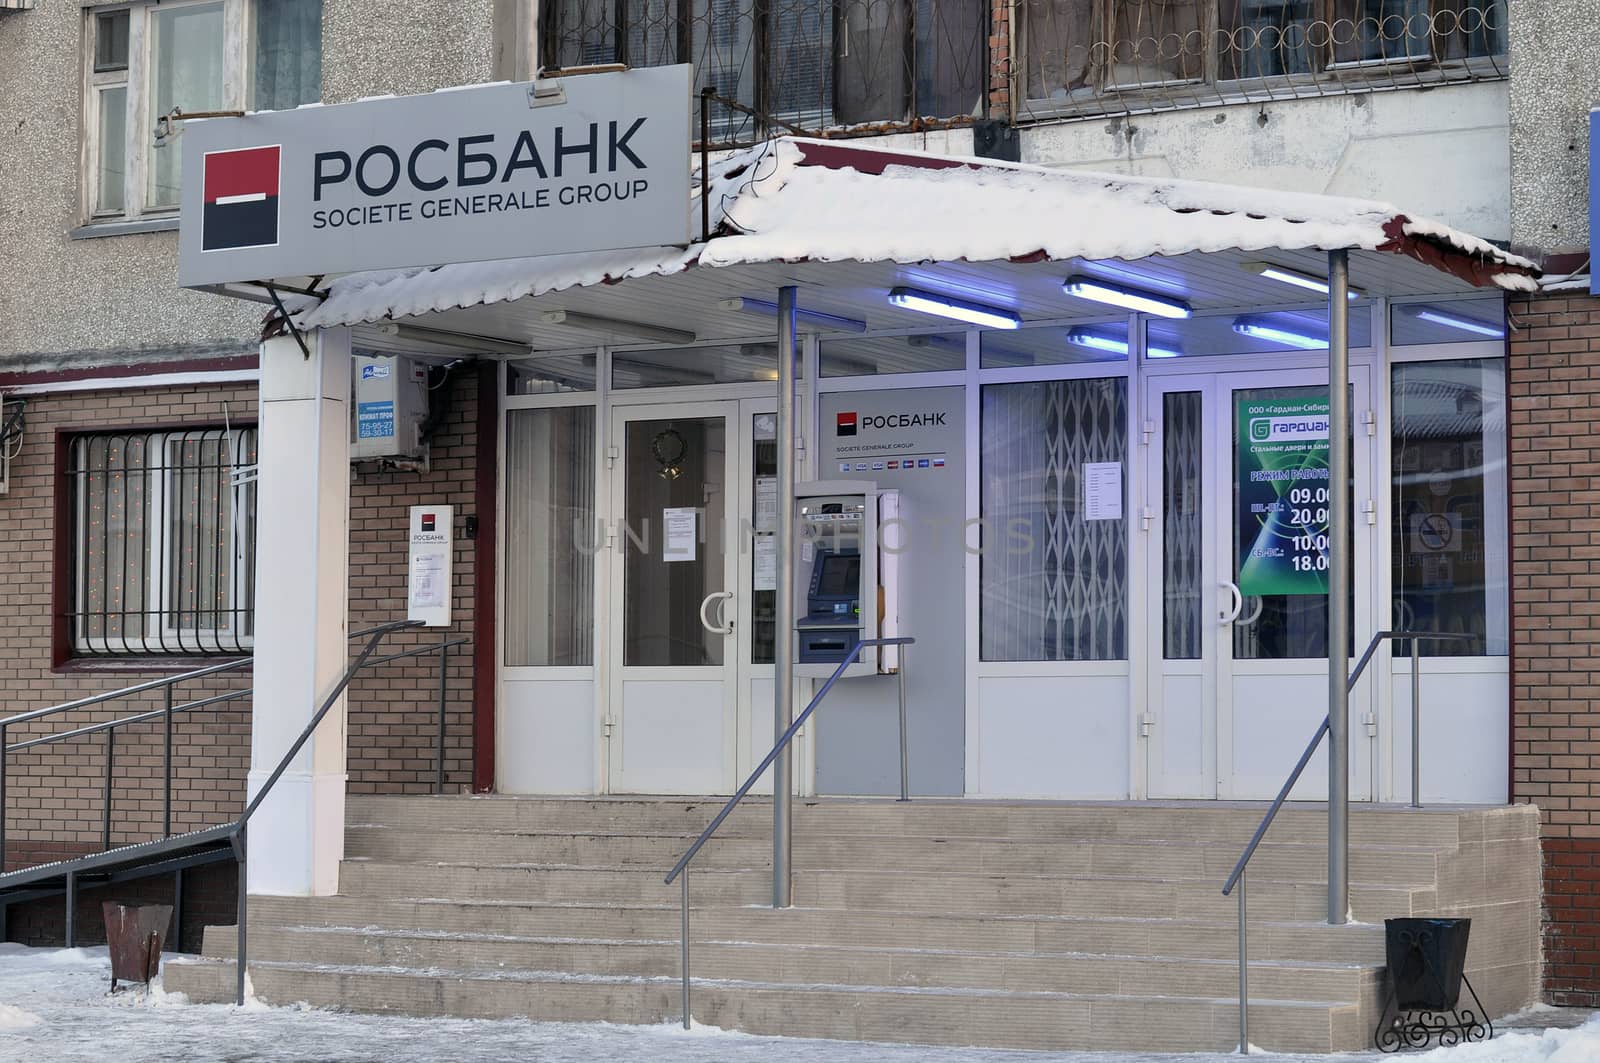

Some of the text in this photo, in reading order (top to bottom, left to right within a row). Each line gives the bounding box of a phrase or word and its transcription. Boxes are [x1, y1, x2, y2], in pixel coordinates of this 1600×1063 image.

[313, 117, 648, 202] РОСБАНК
[313, 179, 648, 229] SOCIETE GENERALE GROUP
[862, 412, 947, 429] РОСБАНК
[862, 443, 892, 451] GENERALE
[1250, 470, 1289, 482] РЕЖИМ
[1290, 487, 1329, 504] 09.0
[1290, 508, 1329, 524] 20.0
[1292, 535, 1329, 551] 10.0
[1292, 555, 1329, 571] 18.0
